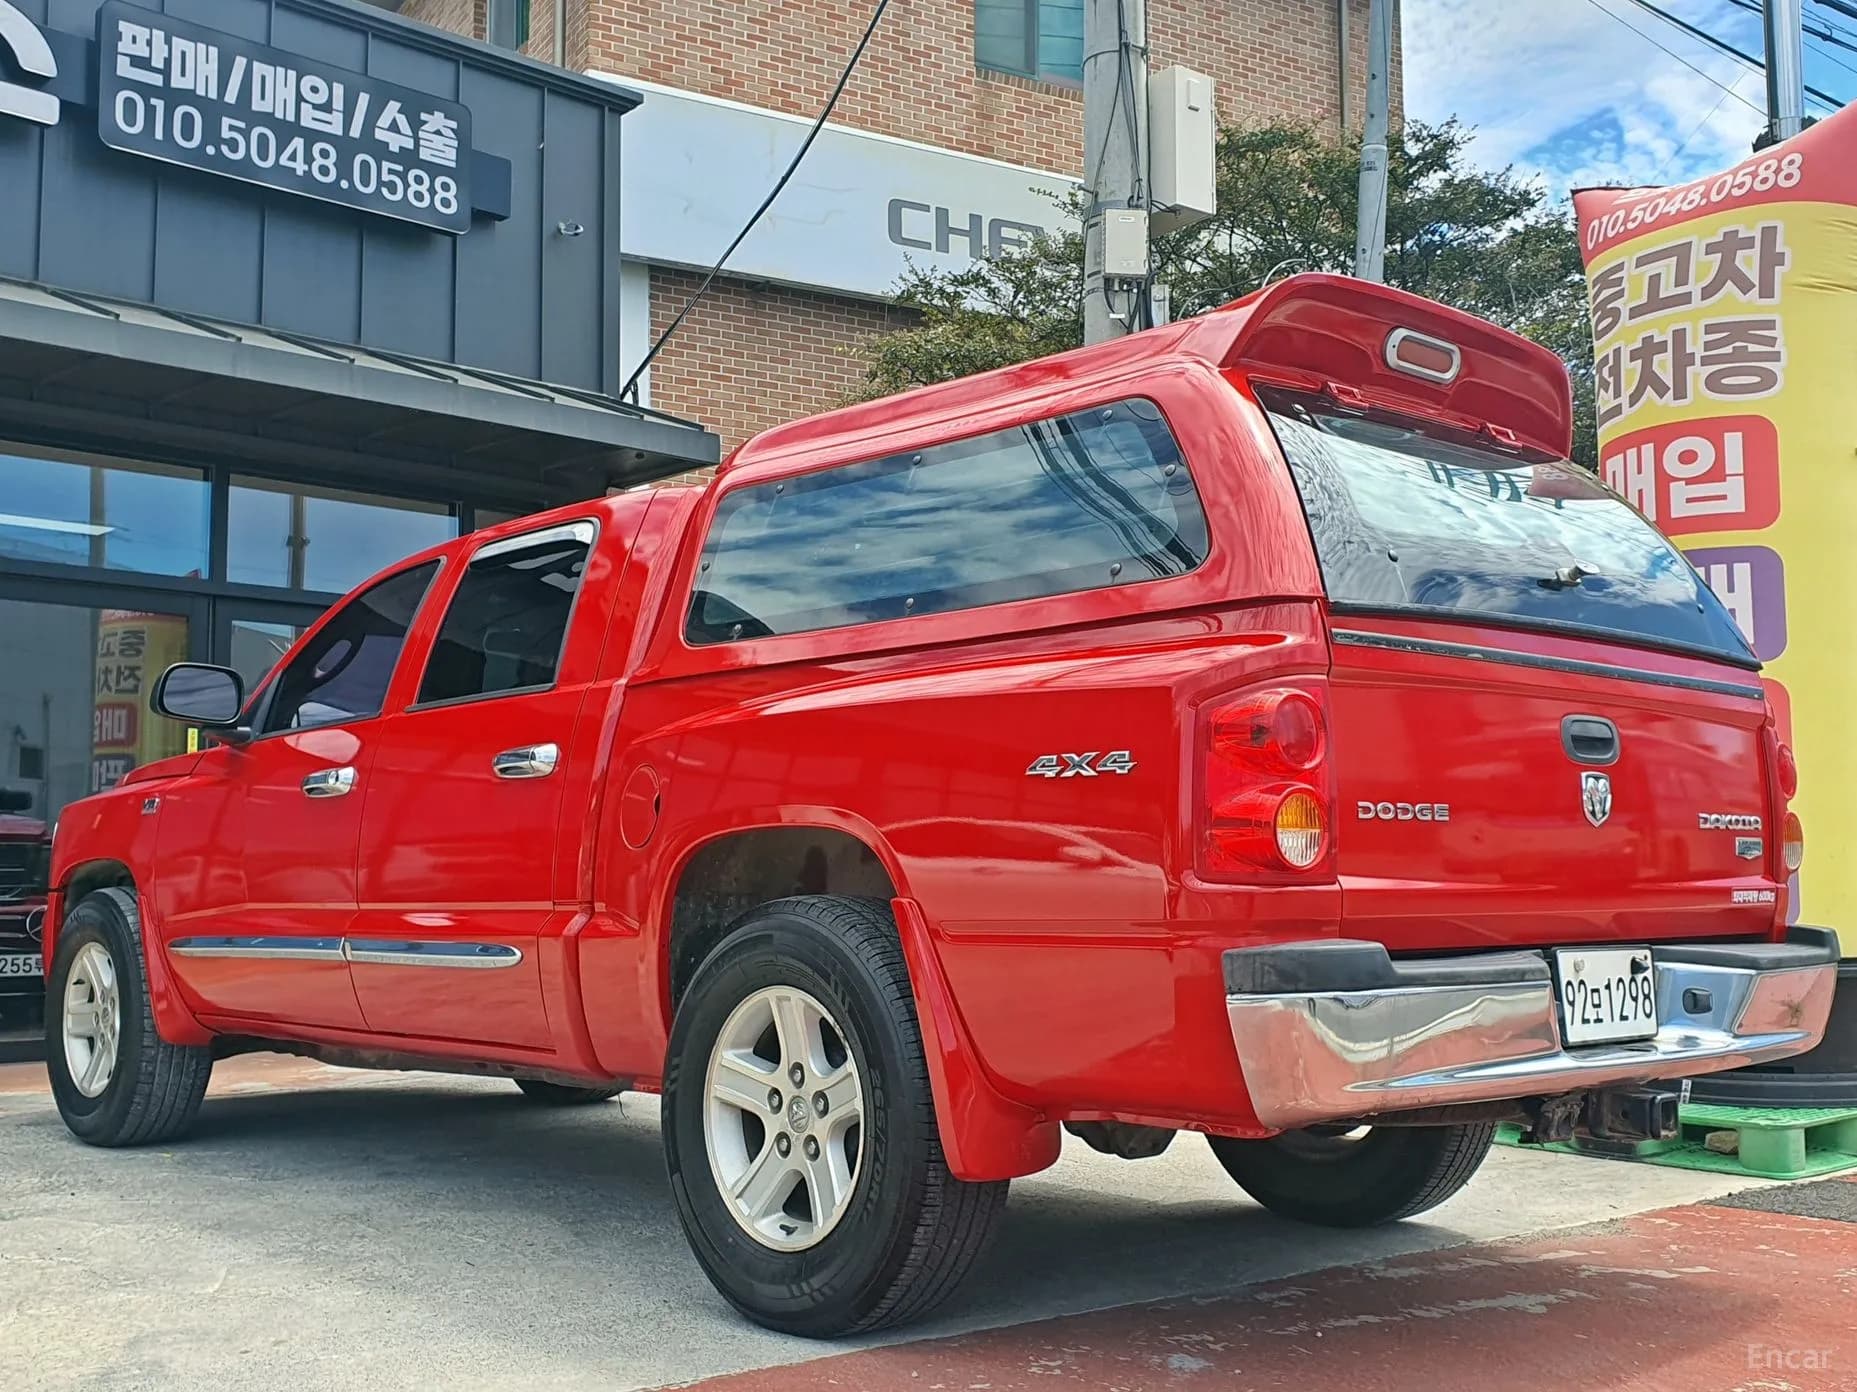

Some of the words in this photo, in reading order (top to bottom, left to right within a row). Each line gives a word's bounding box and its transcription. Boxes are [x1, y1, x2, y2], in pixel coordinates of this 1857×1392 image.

[115, 19, 459, 169] 판매/매입/수출
[114, 89, 459, 215] 010.5048.0588
[1586, 151, 1804, 251] 010.5048.0588
[1591, 224, 1786, 342] 중고차
[1596, 318, 1782, 430] 전차종
[1605, 431, 1746, 523] 매입
[1356, 800, 1450, 821] DODGE
[1564, 974, 1654, 1027] 92모1298
